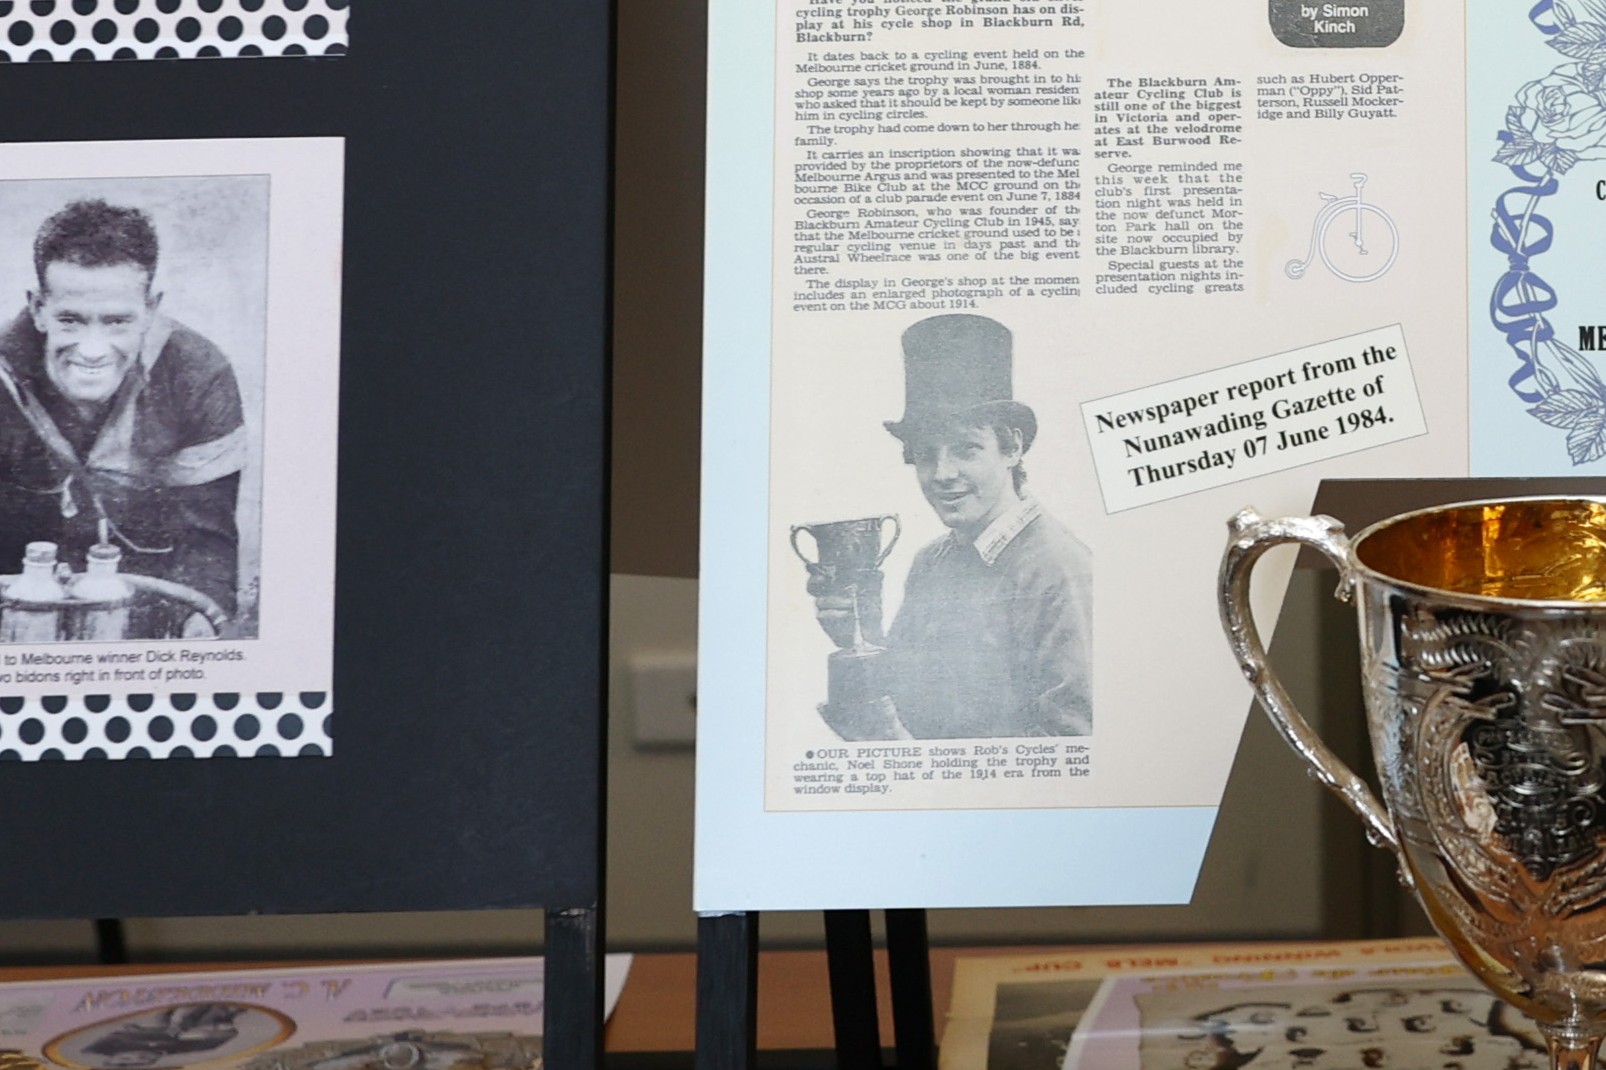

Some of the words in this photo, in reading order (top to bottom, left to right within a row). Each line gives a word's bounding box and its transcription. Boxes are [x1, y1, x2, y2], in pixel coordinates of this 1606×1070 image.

[795, 5, 843, 21] cycling
[846, 4, 891, 21] trophy
[895, 4, 942, 21] George
[945, 4, 1009, 21] Robinson
[1013, 4, 1036, 21] has
[1039, 5, 1057, 16] on
[1060, 4, 1085, 20] dis-
[1301, 4, 1319, 20] by
[1322, 4, 1369, 17] Simon
[1313, 20, 1356, 33] Kinch
[1106, 76, 1132, 89] The
[1138, 76, 1207, 92] Blackburn
[1213, 76, 1241, 91] Am-
[1256, 73, 1287, 86] such
[1290, 74, 1305, 85] as
[1309, 72, 1355, 85] Hubert
[1358, 72, 1404, 87] Opper-
[1094, 389, 1220, 433] Newspaper
[1226, 368, 1297, 402] report
[1301, 354, 1357, 382] from
[1362, 344, 1398, 367] the
[1122, 409, 1267, 458] Nunawading
[1271, 386, 1356, 420] Gazette
[1362, 374, 1386, 397] of
[1127, 447, 1237, 487] Thursday
[1243, 435, 1268, 458] 07
[1276, 423, 1330, 451] June
[1335, 405, 1395, 436] 1984.
[4, 654, 17, 667] to
[21, 652, 94, 666] Melbourne
[97, 652, 143, 665] winner
[146, 649, 175, 664] Dick
[180, 648, 247, 666] Reynolds.
[817, 748, 849, 759] OUR
[857, 747, 922, 758] PICTURE
[928, 745, 967, 757] shows
[974, 744, 1008, 756] Rob's
